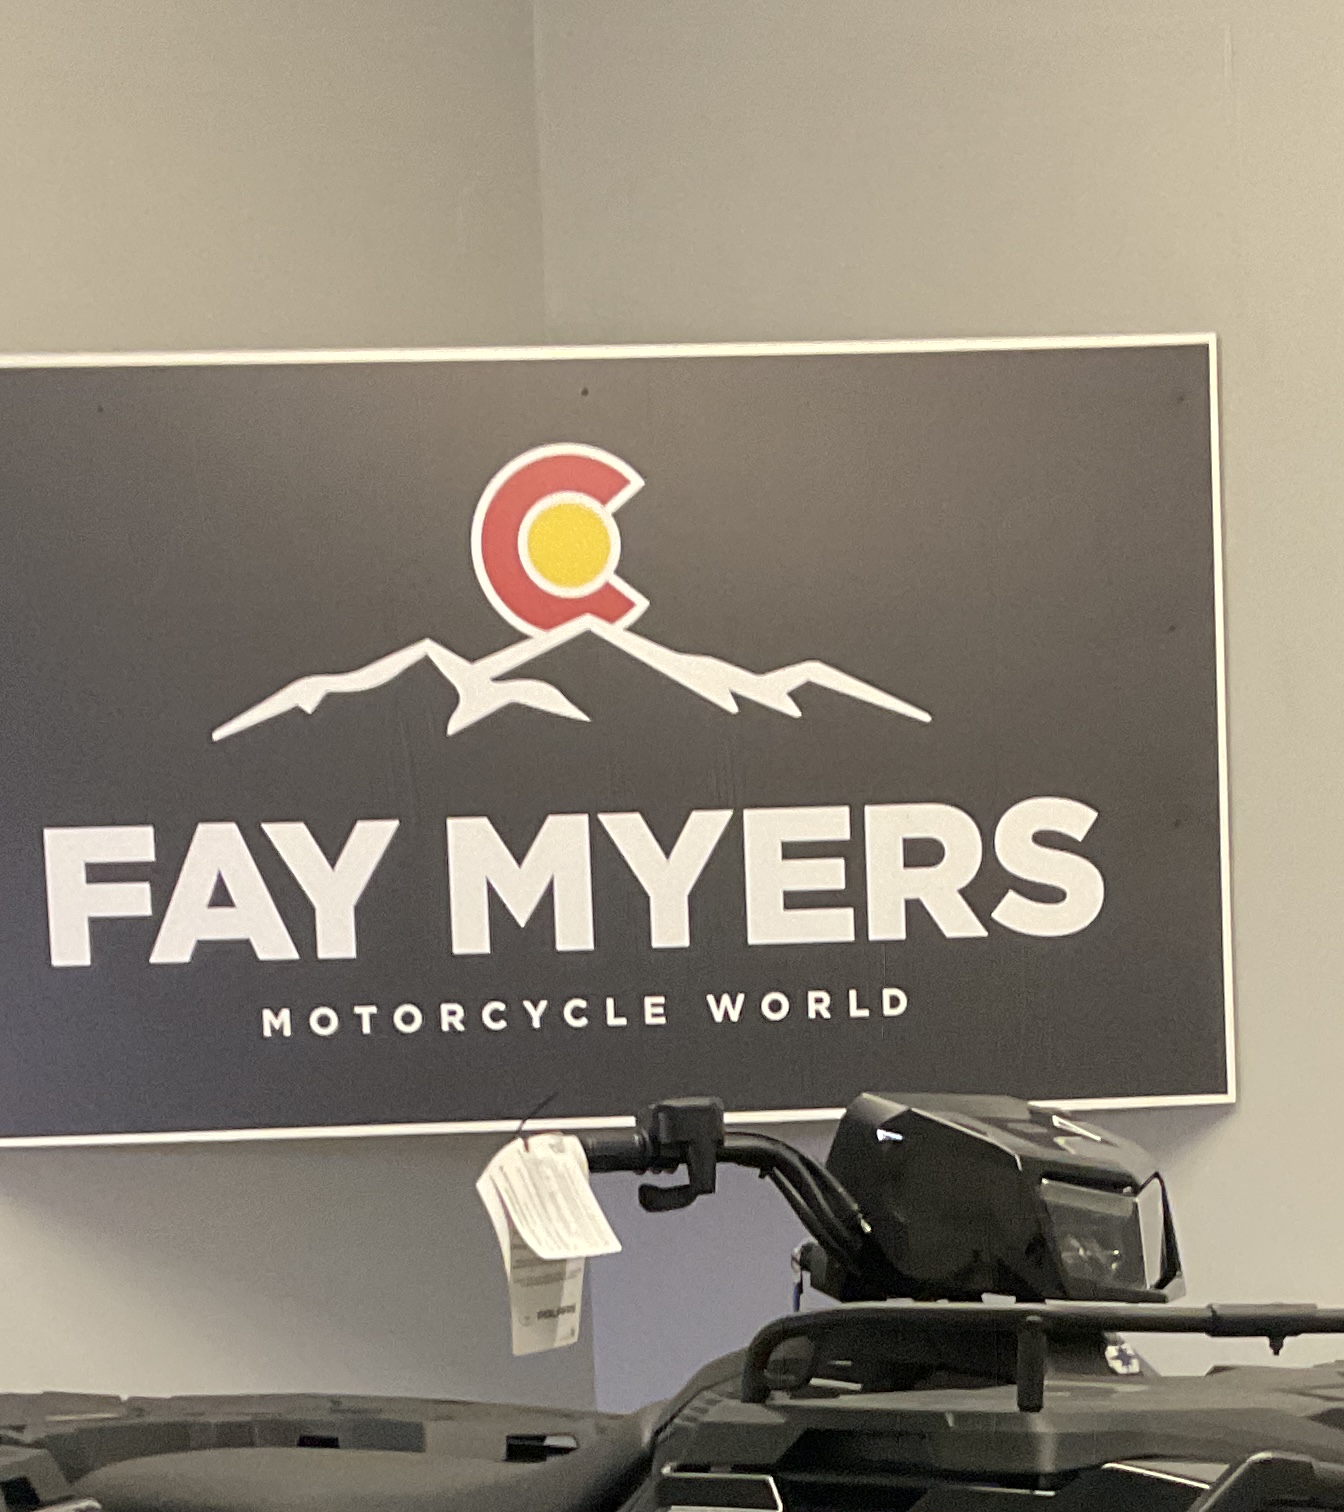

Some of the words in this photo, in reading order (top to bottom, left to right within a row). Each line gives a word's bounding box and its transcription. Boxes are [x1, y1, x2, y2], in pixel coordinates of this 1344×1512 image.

[44, 820, 400, 967] FAY
[447, 797, 1104, 954] MYERS
[263, 996, 666, 1037] MOTORCYCLE
[707, 988, 907, 1022] WORLD
